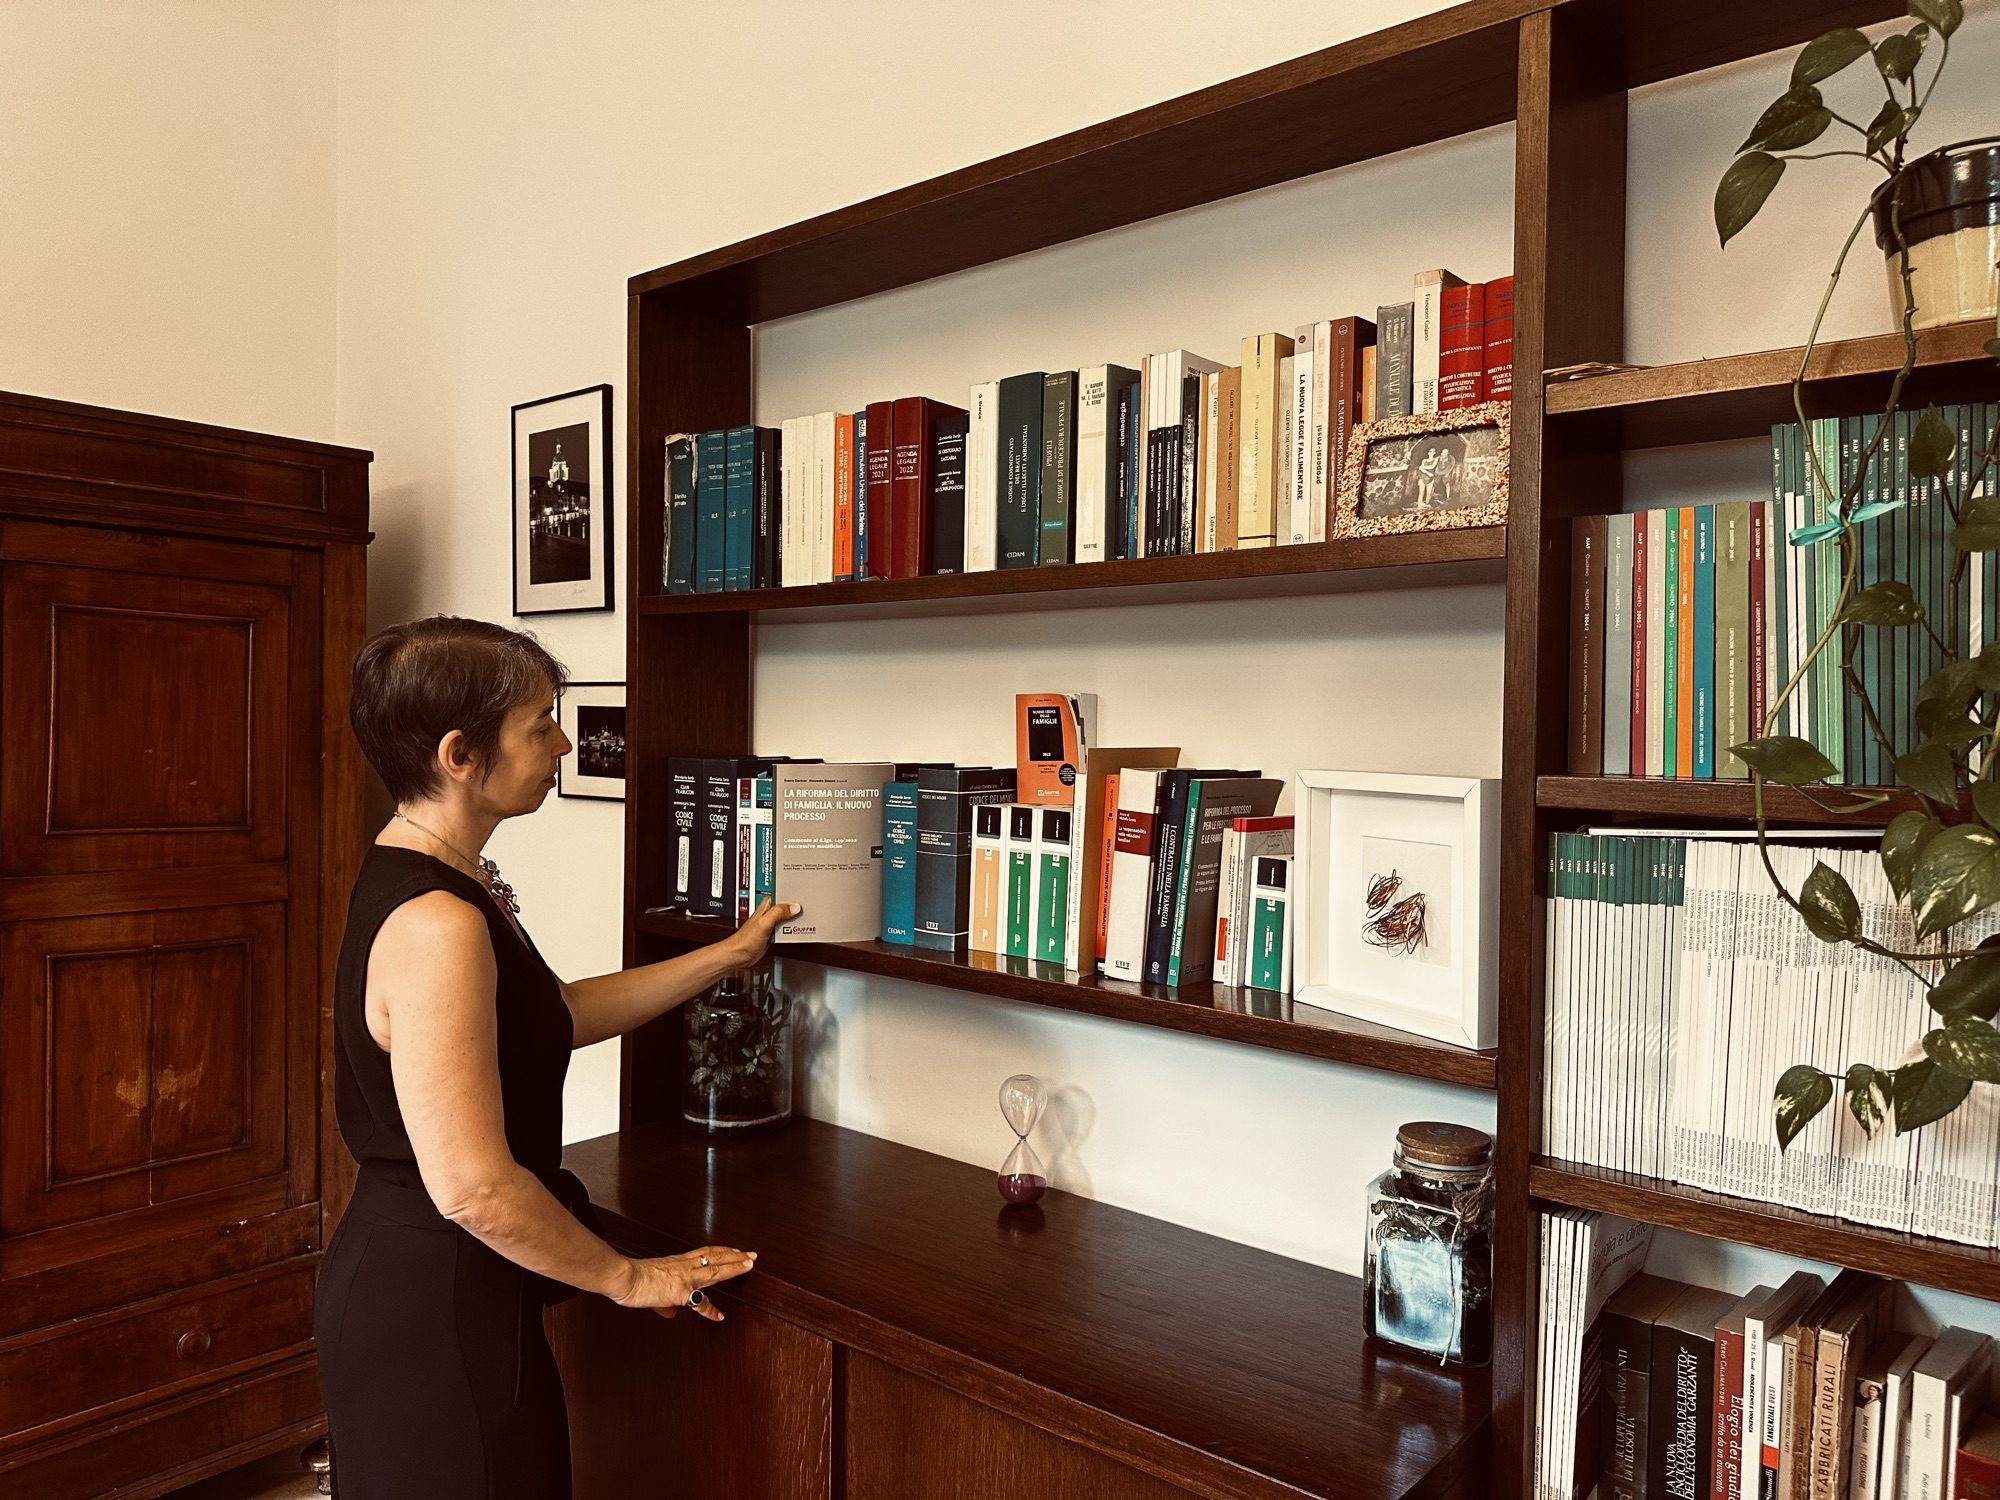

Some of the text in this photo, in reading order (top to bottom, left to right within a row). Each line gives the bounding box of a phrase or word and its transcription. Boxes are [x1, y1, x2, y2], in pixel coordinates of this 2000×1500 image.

[1299, 374, 1305, 385] LA
[1389, 353, 1401, 395] MANUALE
[1389, 398, 1400, 408] DI
[896, 450, 918, 458] AGENDA
[896, 457, 917, 465] LEGALE
[869, 463, 888, 471] LEGALE
[899, 466, 914, 474] 2022
[1297, 441, 1305, 501] FALLIMENTARE
[871, 470, 884, 479] 2021
[784, 788, 879, 798] LA RIFORMA DEL DIRITTO
[784, 800, 872, 809] DI FAMIGLIA: IL NUOVO
[969, 796, 988, 805] CODICE
[675, 811, 694, 819] CODICE
[783, 812, 826, 820] PROCESSO
[1205, 807, 1223, 817] RIFORMA
[1230, 805, 1252, 815] PROCESSO
[676, 818, 692, 827] CIVILE
[709, 814, 728, 823] CODICE
[711, 822, 727, 831] CIVILE
[1203, 821, 1212, 830] PER
[1166, 829, 1176, 871] CONTRATTI
[1164, 871, 1173, 894] NELLA
[1160, 895, 1170, 928] FAMIGLIA
[1677, 1354, 1687, 1399] DIRITTO
[1677, 1399, 1687, 1421] DEL
[1767, 1385, 1776, 1442] TANGENZIALE OVEST
[1716, 1339, 1728, 1493] PIERO CALAMANDREI scritto da un avvocato
[1684, 1354, 1697, 1500] DELL'ECONOMIA GARZANTI
[1817, 1363, 1836, 1493] FABBRICATI RURALI
[1725, 1395, 1743, 1500] Elogio dei giudic
[1675, 1421, 1687, 1497] ENCICLOPEDIA
[1666, 1443, 1677, 1494] LA NUOVA
[1859, 1453, 1868, 1489] PERSUASIONE
